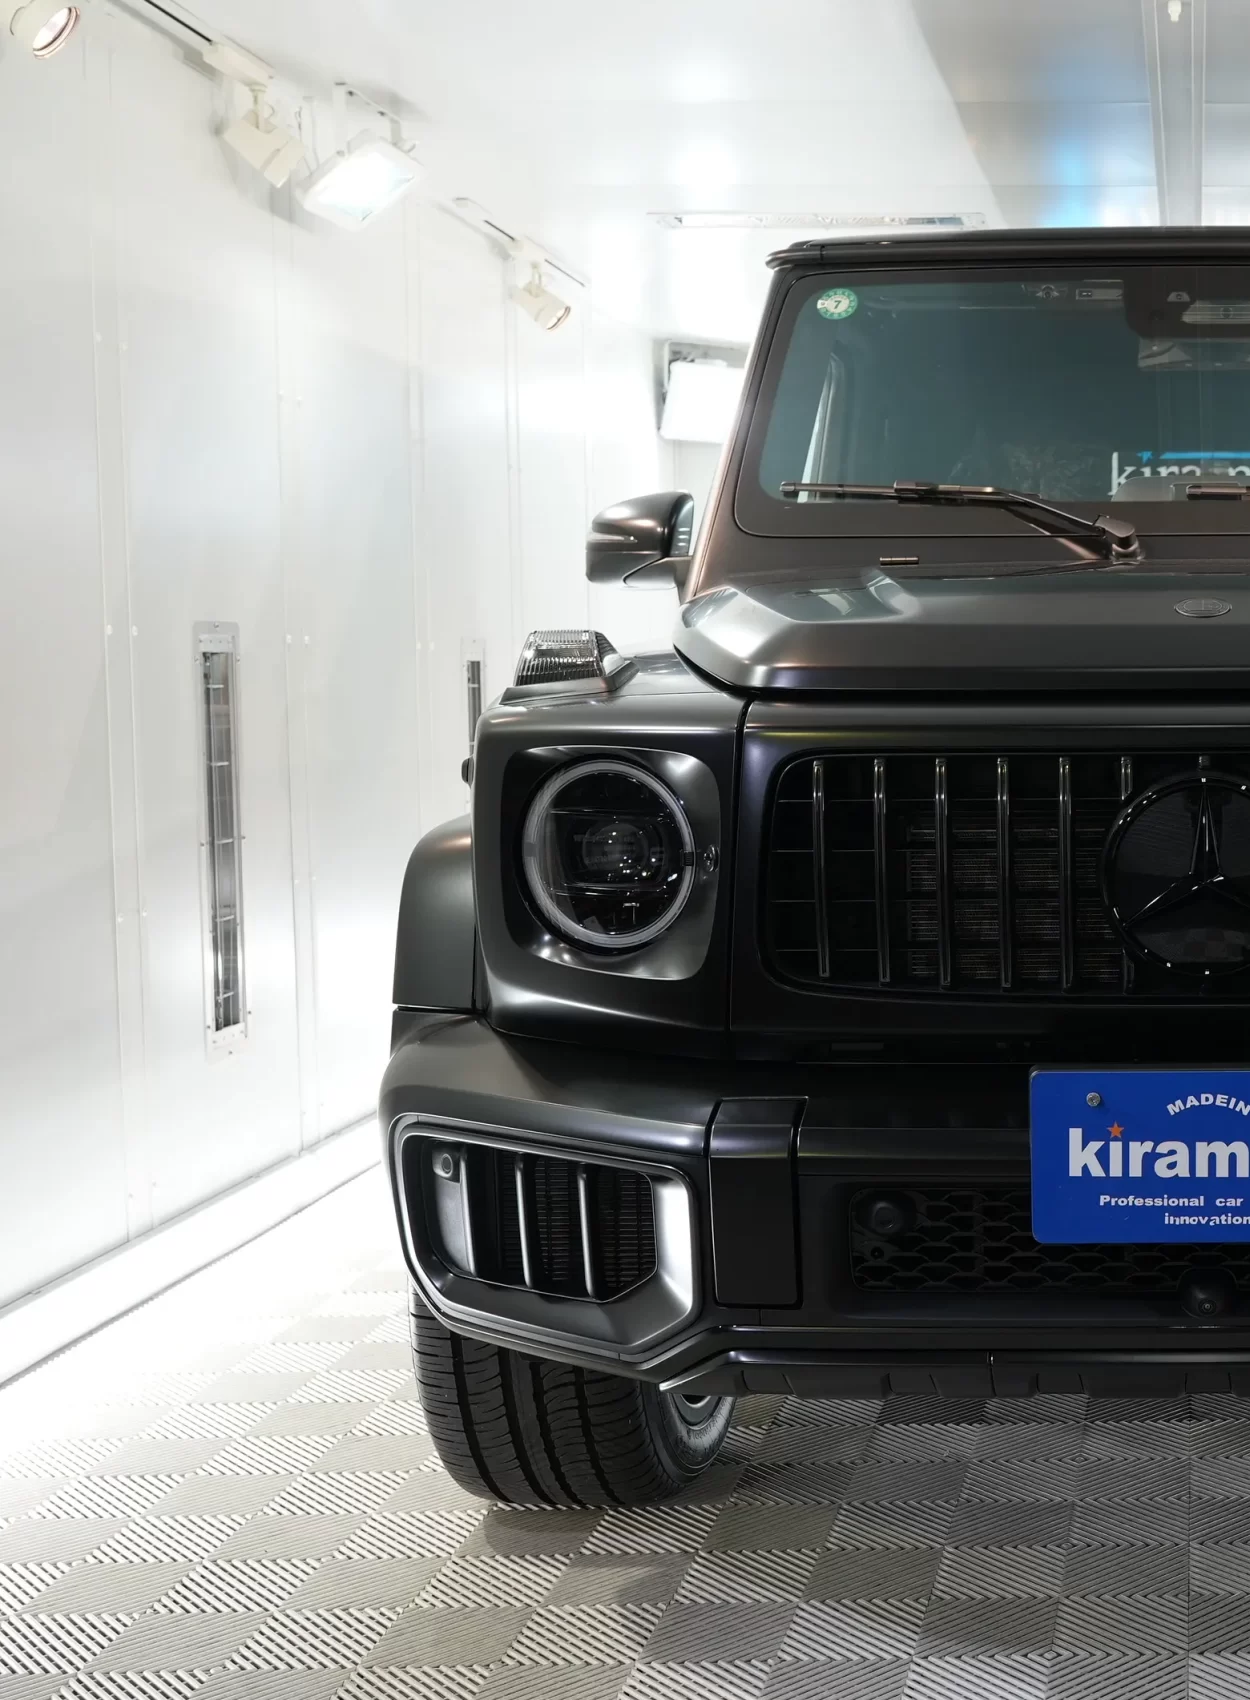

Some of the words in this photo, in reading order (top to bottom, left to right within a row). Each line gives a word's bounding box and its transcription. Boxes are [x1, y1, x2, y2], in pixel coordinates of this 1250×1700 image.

[833, 300, 842, 309] 7
[1099, 1194, 1205, 1207] Professional
[1215, 1198, 1244, 1207] car
